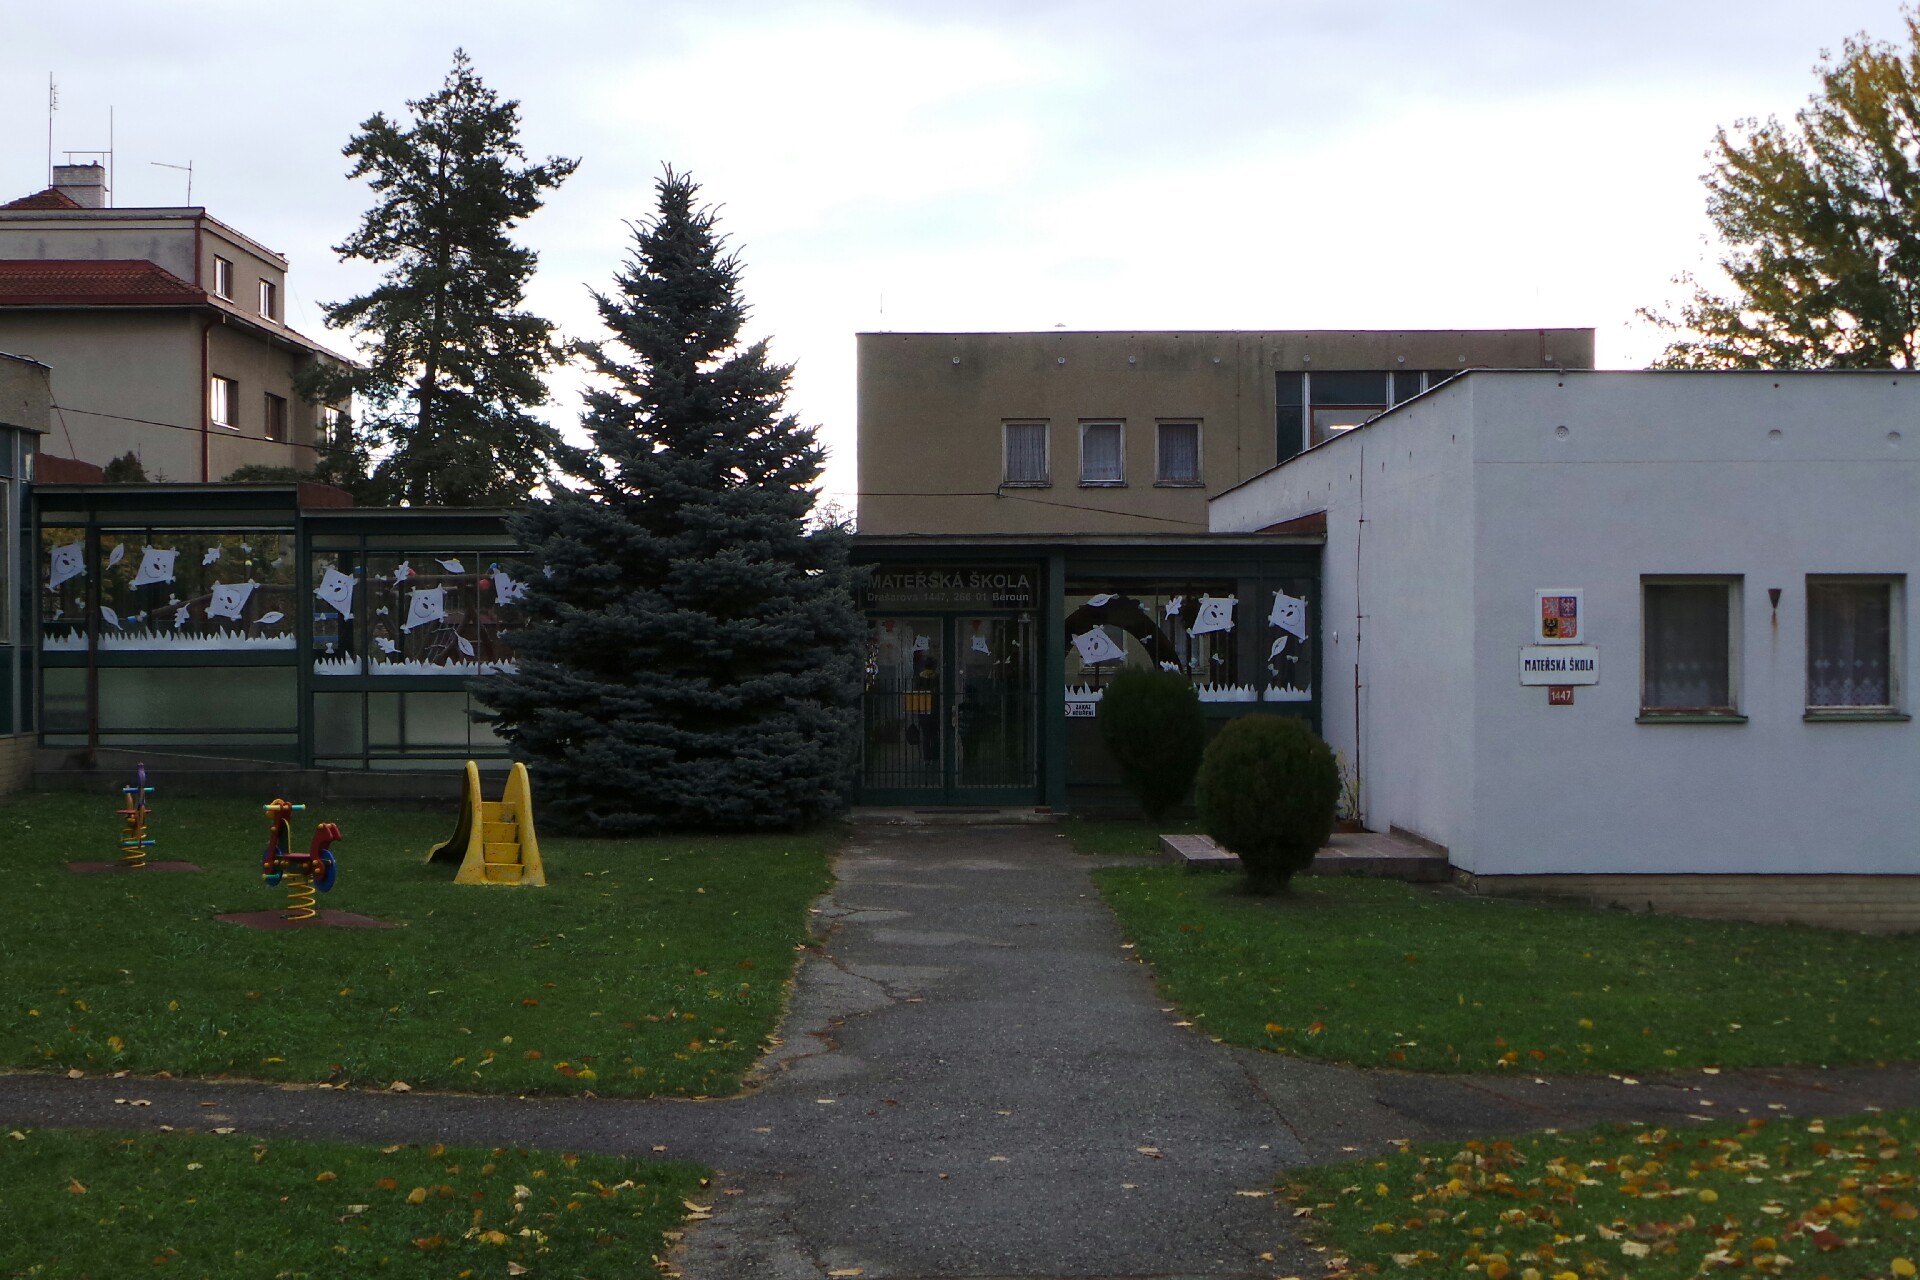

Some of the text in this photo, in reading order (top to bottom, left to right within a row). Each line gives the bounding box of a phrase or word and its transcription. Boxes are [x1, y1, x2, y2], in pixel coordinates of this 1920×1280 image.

[867, 571, 1030, 589] MATEŘSKÁ ŠKOLA
[953, 592, 971, 601] 266
[975, 592, 987, 601] 01
[992, 592, 1029, 601] Beroun
[1524, 657, 1594, 671] MATEŘSKÁ ŠKOLA
[1551, 690, 1571, 701] 1447
